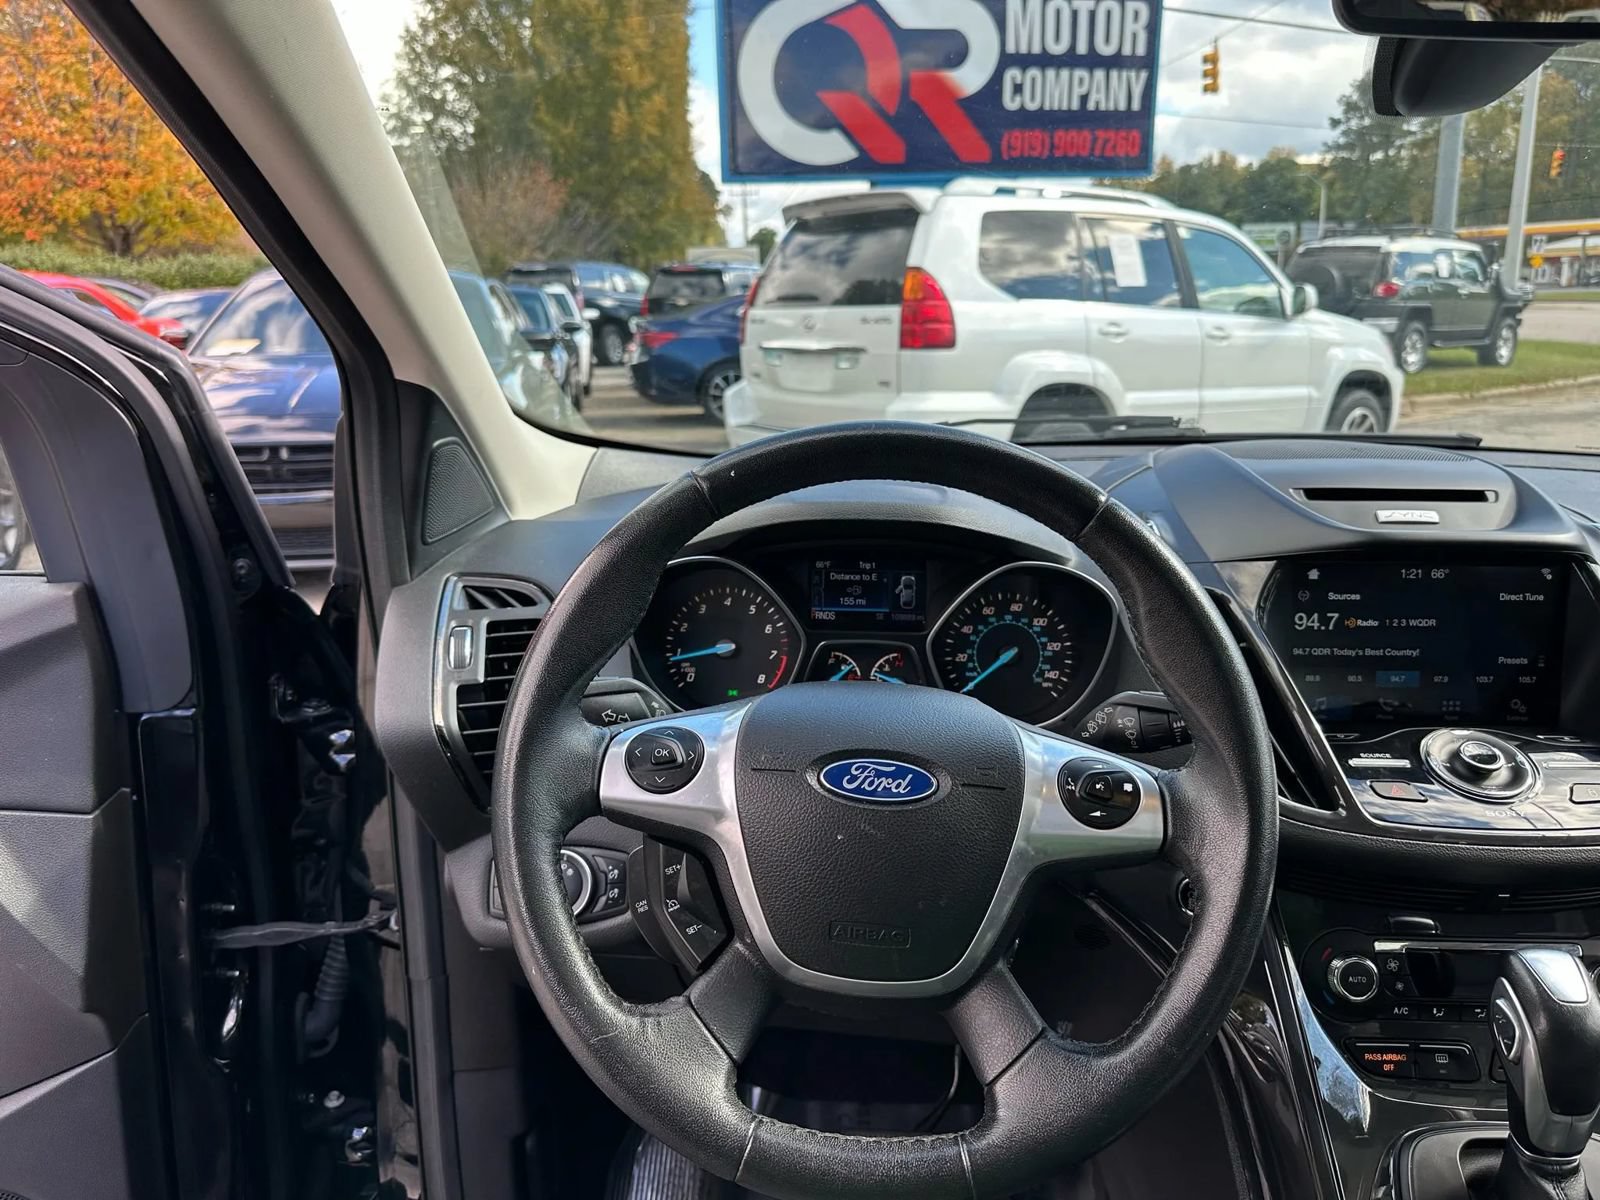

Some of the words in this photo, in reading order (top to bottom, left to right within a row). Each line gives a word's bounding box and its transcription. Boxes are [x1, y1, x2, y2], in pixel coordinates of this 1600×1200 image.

[1005, 0, 1150, 56] MOTOR
[1002, 66, 1149, 111] COMPANY
[1001, 128, 1050, 160] (919)
[1054, 128, 1091, 158] 900
[1093, 128, 1141, 158] 7260
[859, 561, 871, 570] Trip
[830, 573, 861, 581] Distance
[862, 573, 871, 581] to
[871, 573, 878, 581] E
[1400, 568, 1422, 579] 1:21
[1431, 568, 1450, 579] 66°
[1327, 592, 1361, 600] Sources
[1499, 592, 1523, 601] Direct
[1524, 593, 1545, 601] Tune
[724, 597, 732, 606] 4
[840, 597, 855, 606] 155
[856, 597, 867, 606] mi
[698, 604, 706, 614] 3
[748, 604, 757, 615] 5
[982, 606, 995, 615] 60
[1010, 603, 1023, 612] 80
[1032, 617, 1048, 626] 100
[1294, 612, 1340, 630] 94.7
[1356, 619, 1379, 627] Radio
[1392, 618, 1399, 627] 2
[1400, 618, 1407, 627] 3
[1408, 618, 1436, 627] WQDR
[680, 623, 688, 633] 2
[764, 624, 773, 634] 6
[960, 625, 973, 634] 40
[1046, 642, 1061, 651] 120
[769, 650, 778, 660] 7
[955, 653, 968, 662] 20
[1292, 648, 1309, 656] 94.7
[1311, 648, 1331, 656] QDR
[1332, 648, 1363, 657] Today's
[1364, 648, 1384, 656] Best
[1384, 648, 1420, 657] Country!
[1498, 656, 1528, 665] Presets
[686, 672, 695, 683] 0
[757, 674, 766, 684] 8
[1044, 670, 1060, 679] 140
[654, 747, 670, 757] OK
[842, 762, 913, 794] Ford
[664, 863, 682, 876] SET+
[635, 898, 648, 909] CAN
[637, 904, 649, 914] RES
[833, 924, 905, 942] AIRBAG
[1348, 975, 1367, 984] AUTO
[1393, 1006, 1409, 1016] A/C
[1364, 1053, 1382, 1062] PASS
[1382, 1053, 1407, 1062] AIRBAG
[1383, 1063, 1395, 1072] OFF
